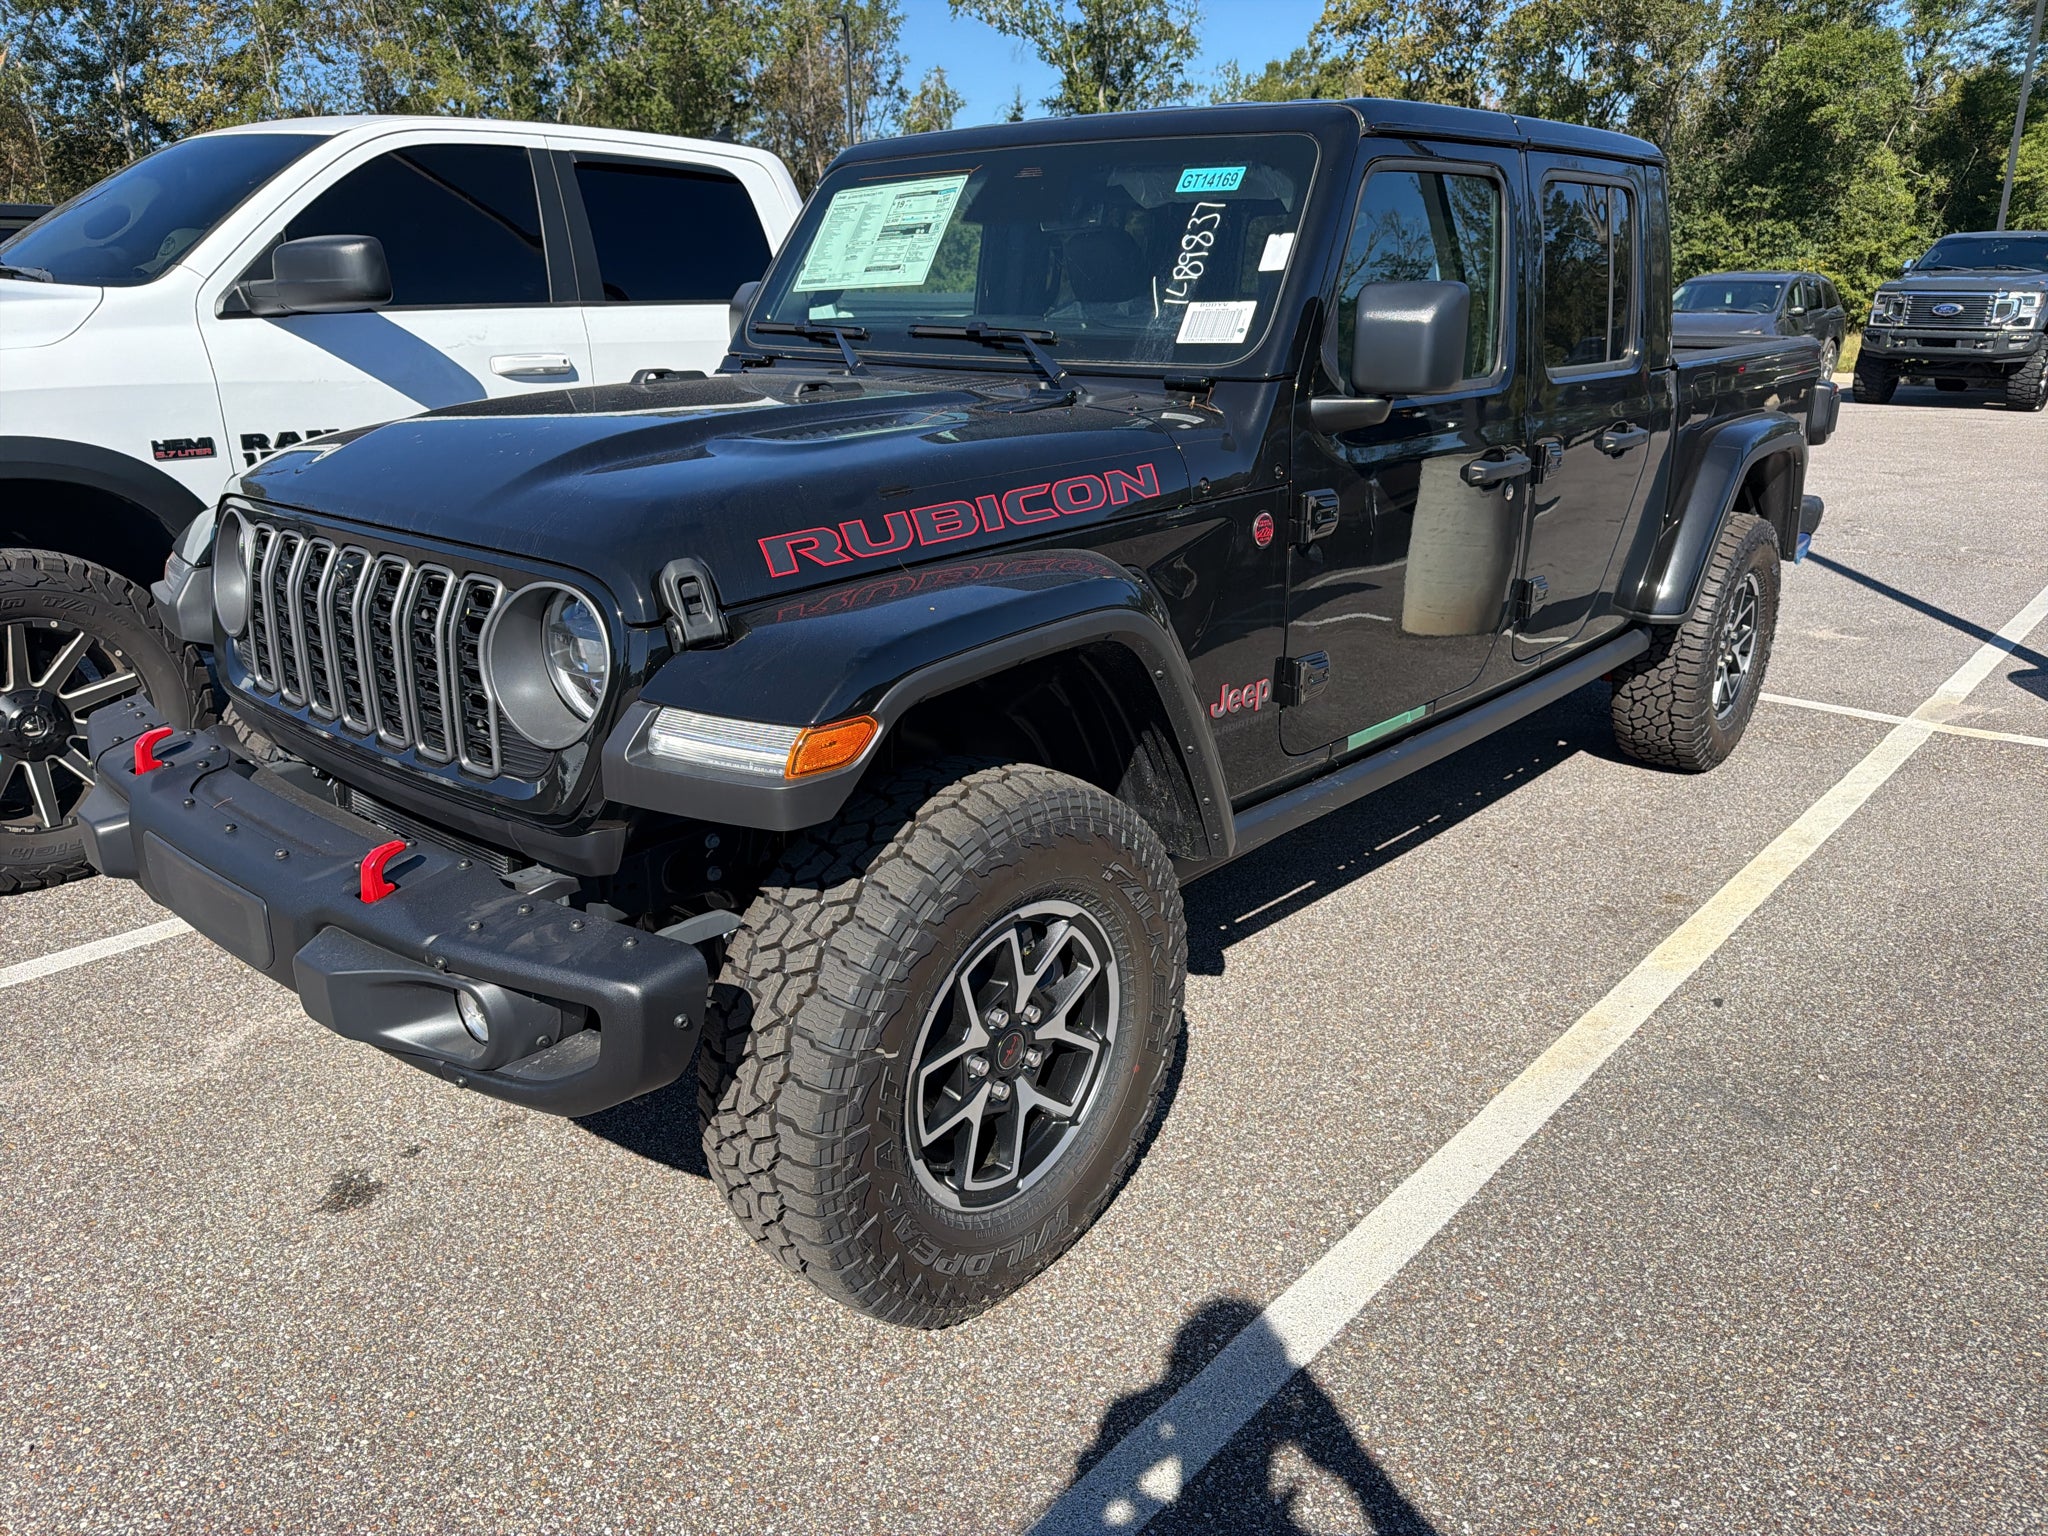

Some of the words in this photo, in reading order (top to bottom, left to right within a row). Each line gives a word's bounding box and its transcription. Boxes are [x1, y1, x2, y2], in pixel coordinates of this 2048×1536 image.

[1181, 172, 1239, 189] GT14169
[151, 437, 213, 451] HEMI
[154, 450, 175, 460] 5.7
[177, 447, 213, 458] LITER
[758, 463, 1161, 578] RUBICON
[1210, 678, 1272, 718] Jeep
[1101, 861, 1168, 1053] FALKEN
[877, 1182, 1070, 1277] WILDPEAK
